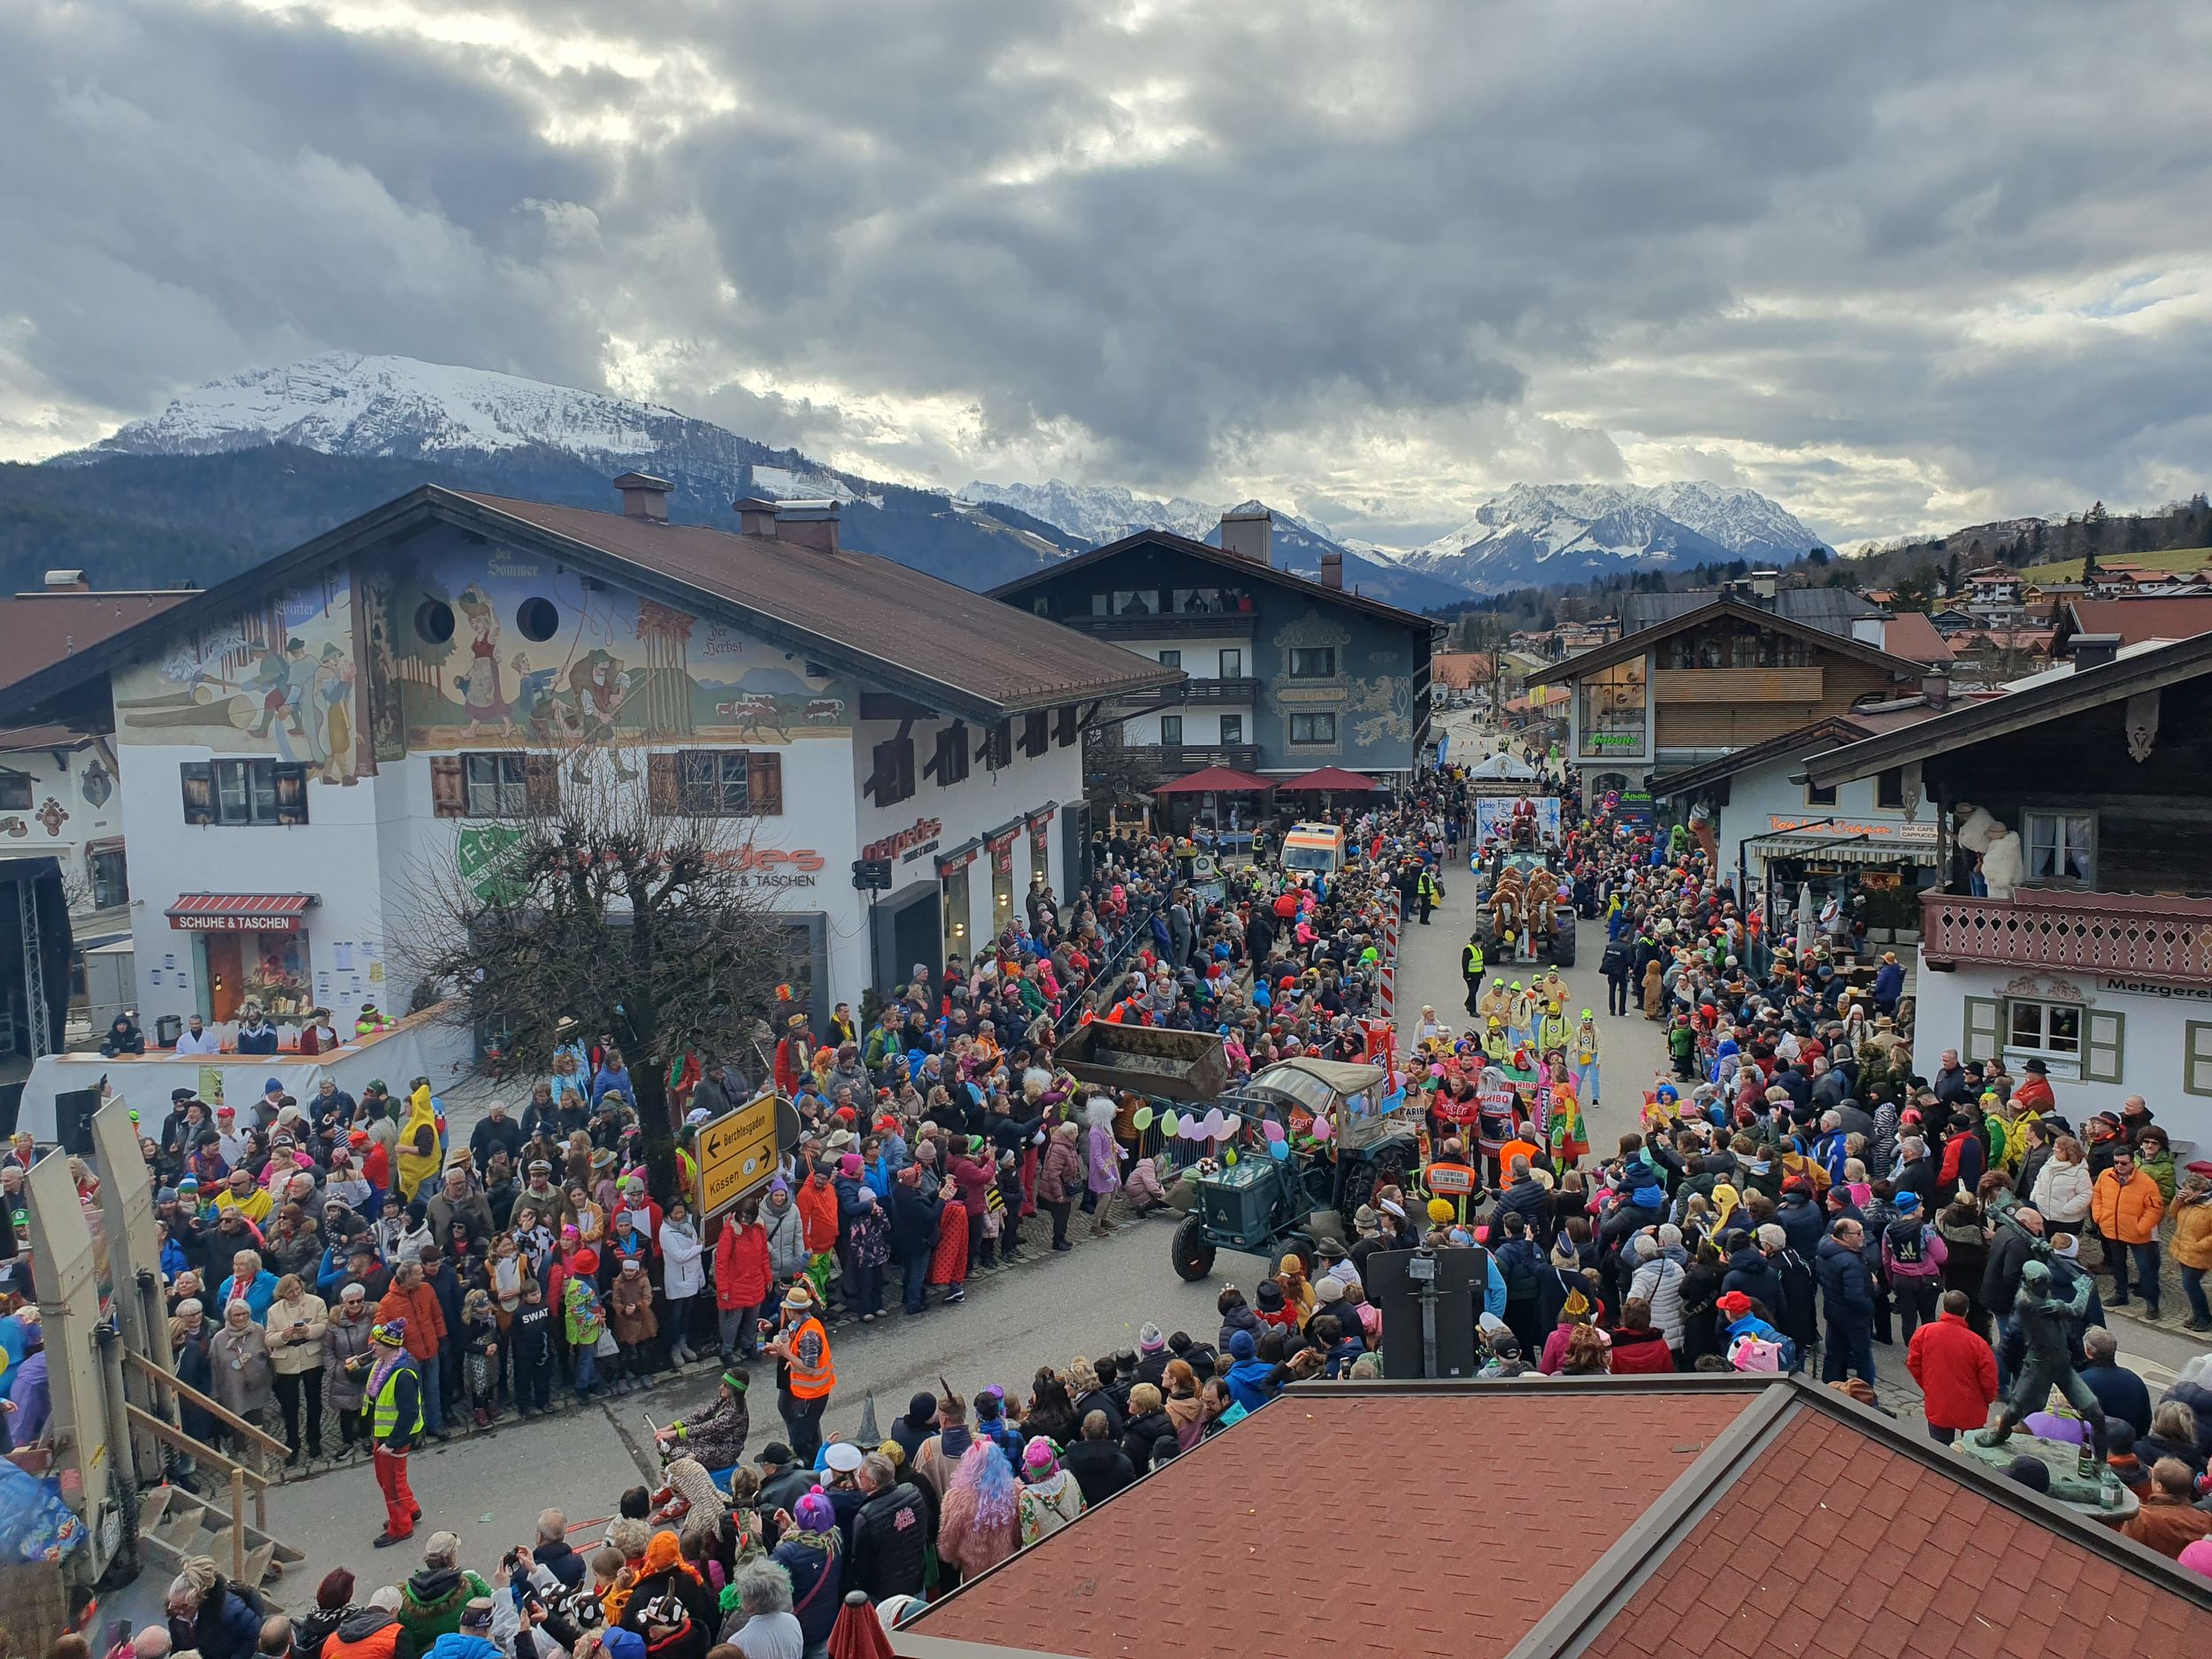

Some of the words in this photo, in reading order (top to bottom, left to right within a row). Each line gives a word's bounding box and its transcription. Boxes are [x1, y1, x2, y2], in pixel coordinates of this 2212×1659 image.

[488, 559, 539, 577] Sommer
[274, 599, 315, 616] Winter
[703, 637, 743, 657] Herbst
[757, 875, 815, 887] TASCHEN
[180, 917, 225, 928] SCHUHE
[227, 918, 235, 928] &
[237, 917, 289, 929] TASCHEN
[1480, 1094, 1509, 1104] ARIBO
[1540, 1088, 1550, 1132] MAOAM
[724, 1115, 765, 1147] Berchtesgaden
[710, 1171, 740, 1195] Kössen
[522, 1308, 549, 1324] SWAT
